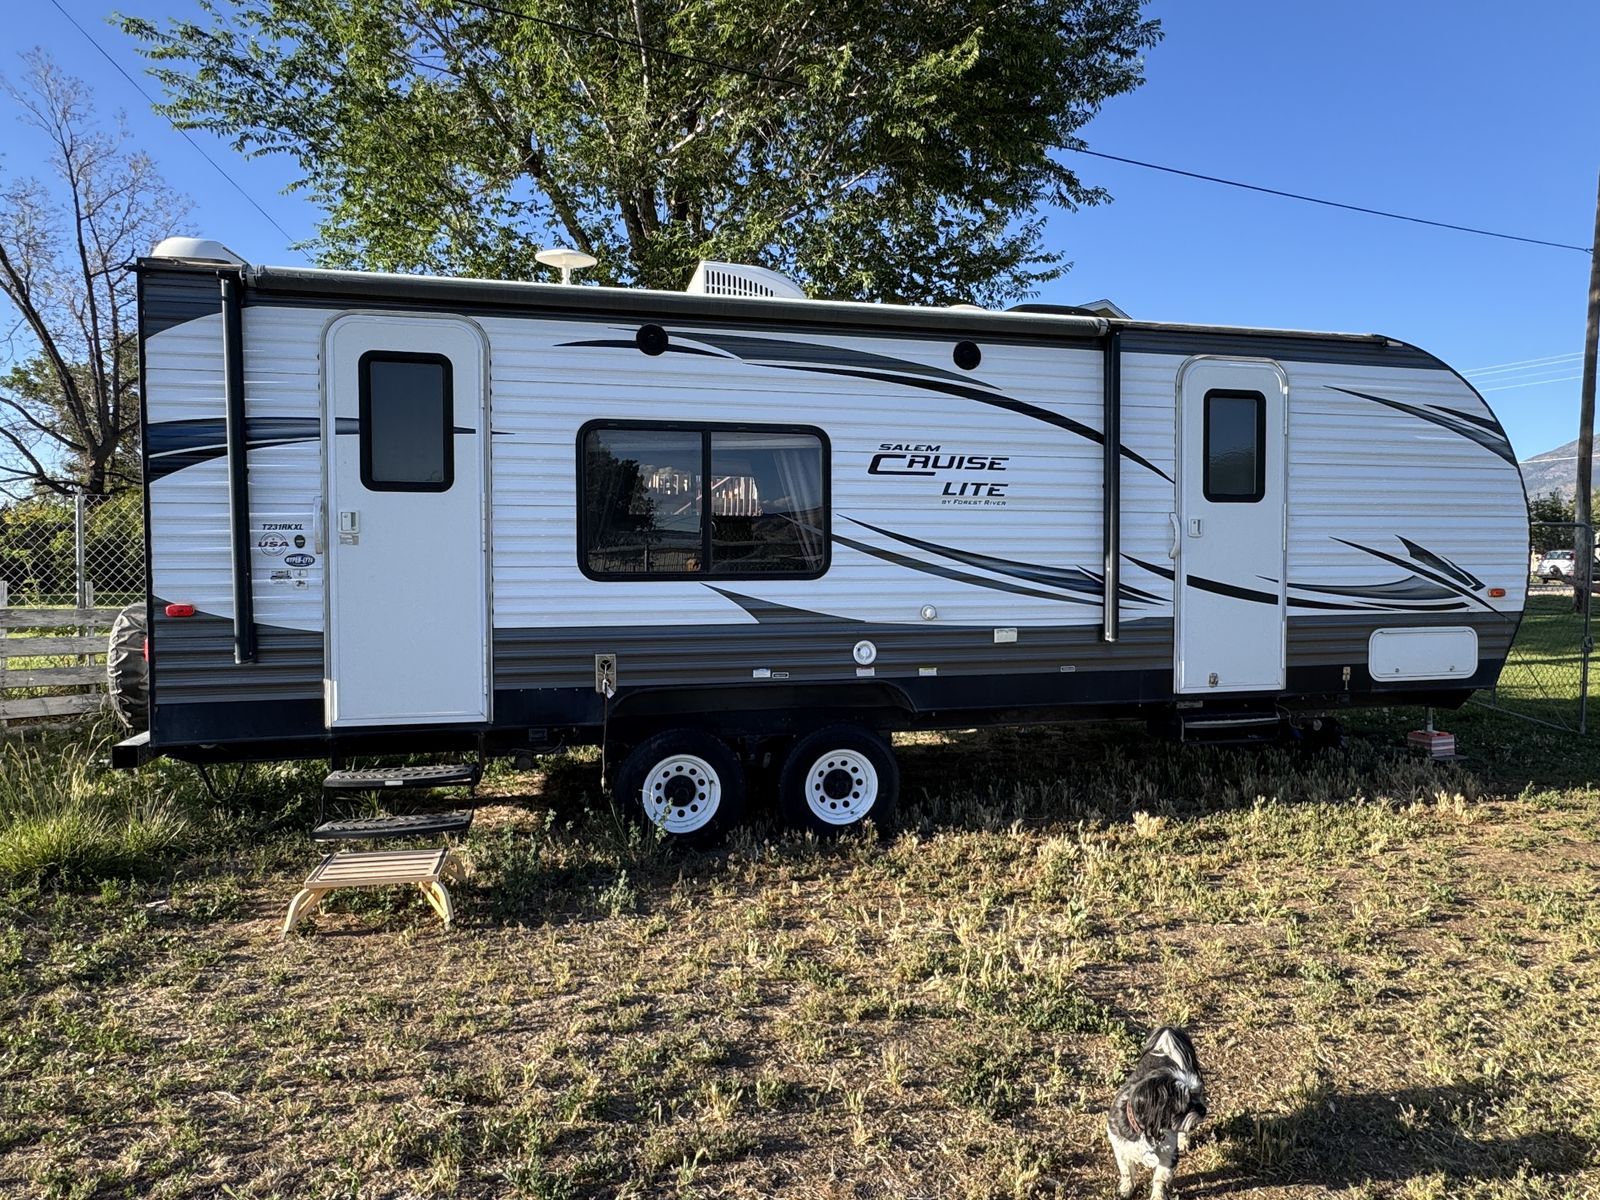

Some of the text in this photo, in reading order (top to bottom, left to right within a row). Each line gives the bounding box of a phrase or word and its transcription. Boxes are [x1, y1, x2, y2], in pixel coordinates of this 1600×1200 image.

[879, 444, 941, 452] SALEM
[868, 454, 1009, 476] CRUISE
[942, 482, 1009, 497] LITE
